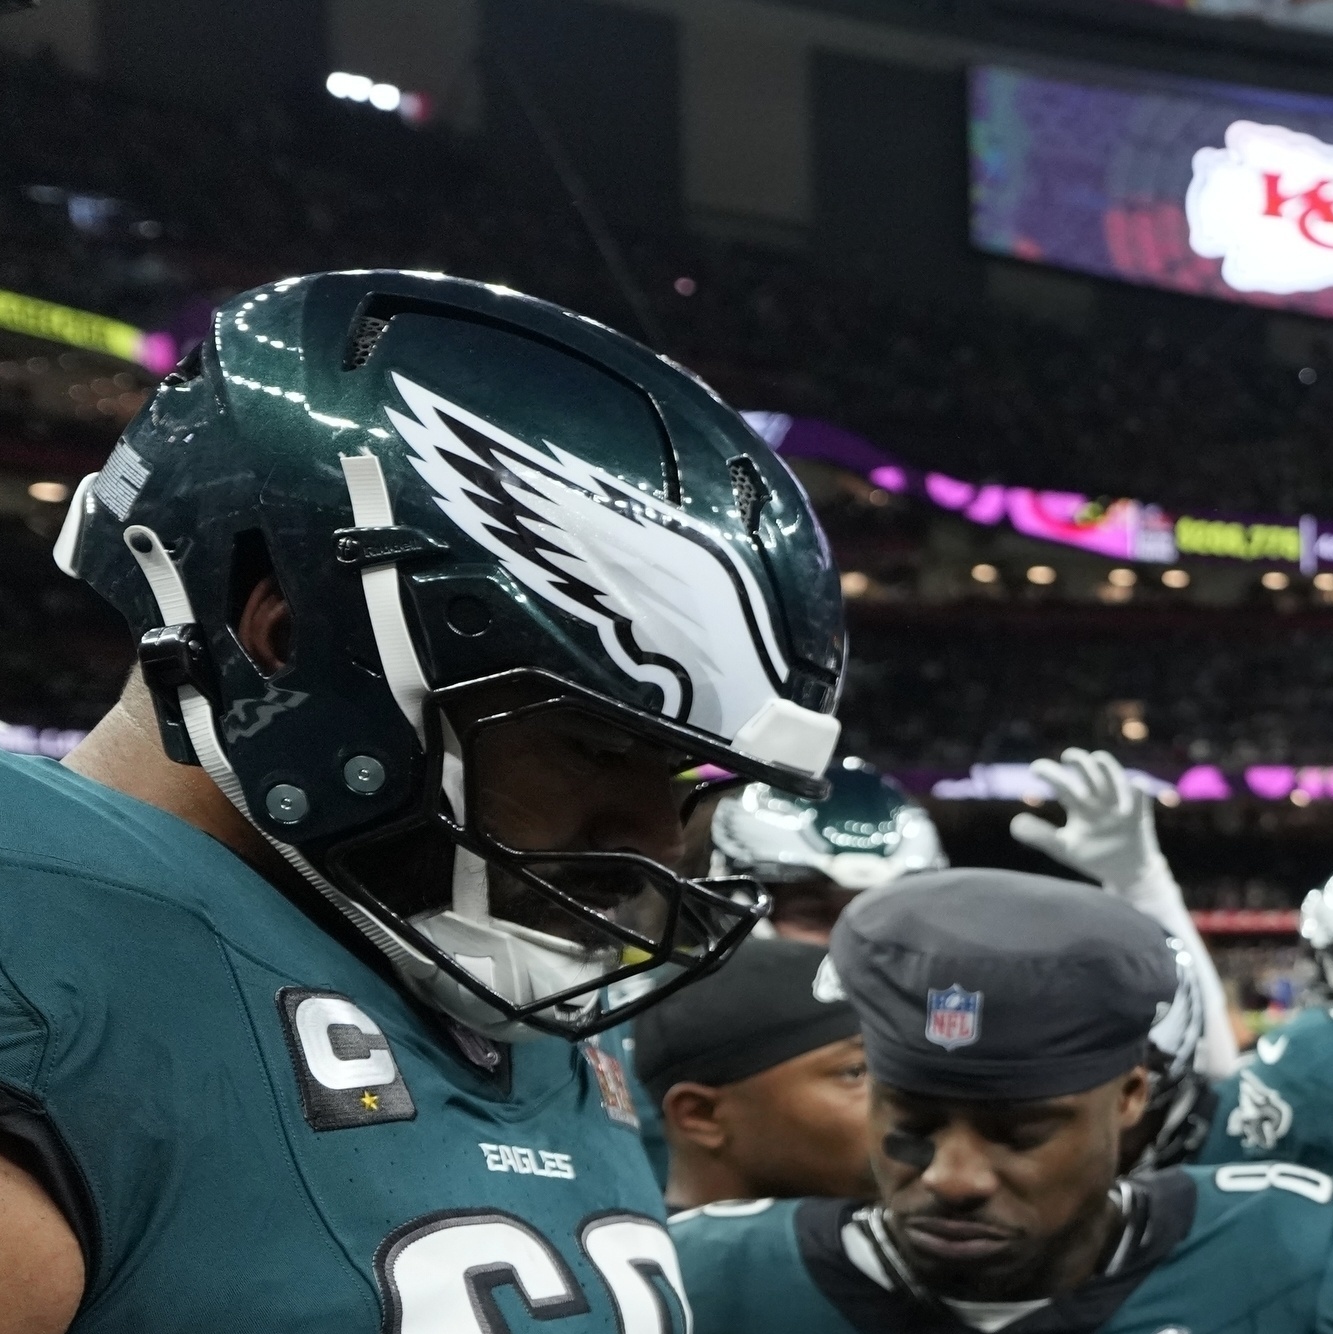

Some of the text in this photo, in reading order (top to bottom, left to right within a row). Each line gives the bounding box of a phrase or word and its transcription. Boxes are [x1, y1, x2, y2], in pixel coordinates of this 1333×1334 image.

[296, 998, 396, 1090] C
[933, 1012, 970, 1038] NFL
[478, 1142, 576, 1180] EAGLES
